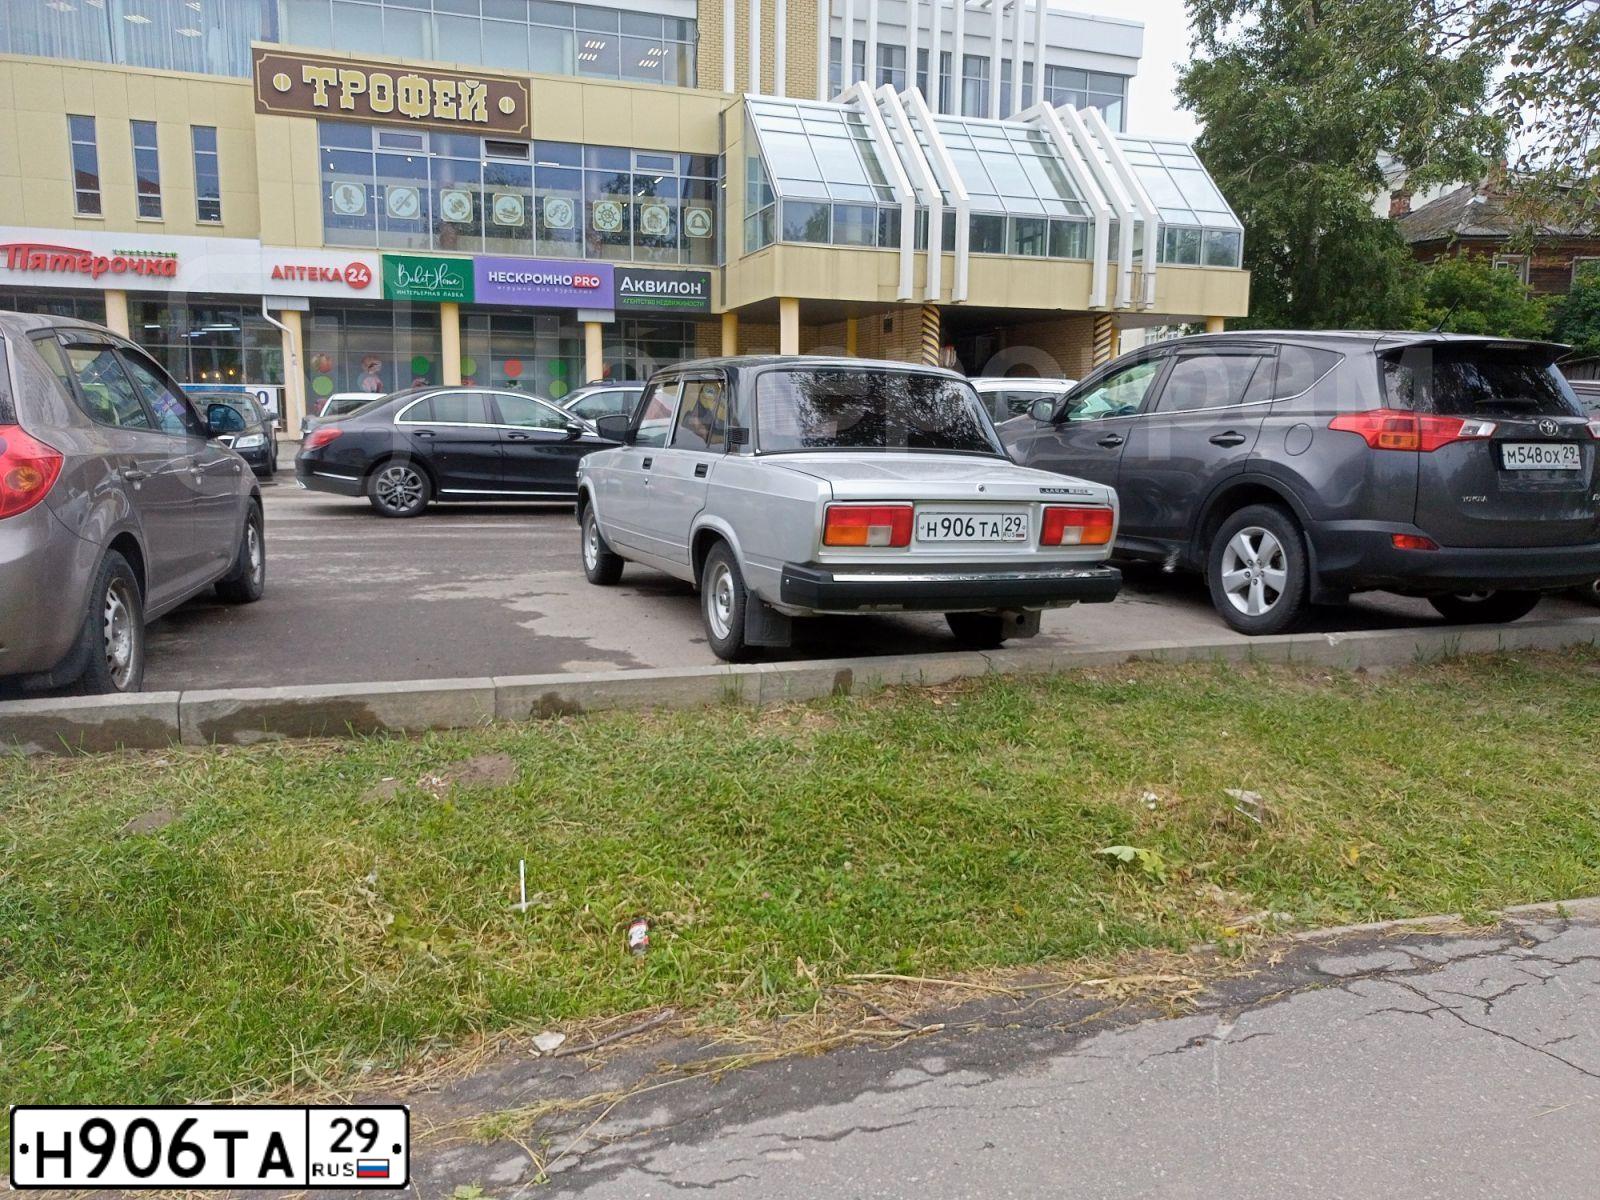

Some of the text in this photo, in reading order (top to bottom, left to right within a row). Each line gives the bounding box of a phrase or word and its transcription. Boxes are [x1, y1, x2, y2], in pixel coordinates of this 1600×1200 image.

[302, 65, 488, 122] ТРОФЕЙ
[271, 265, 369, 284] АПТЕКА 24
[488, 271, 573, 286] НЕСКРОМНО
[1563, 446, 1576, 460] 29
[926, 516, 1022, 538] Н906ТА 29
